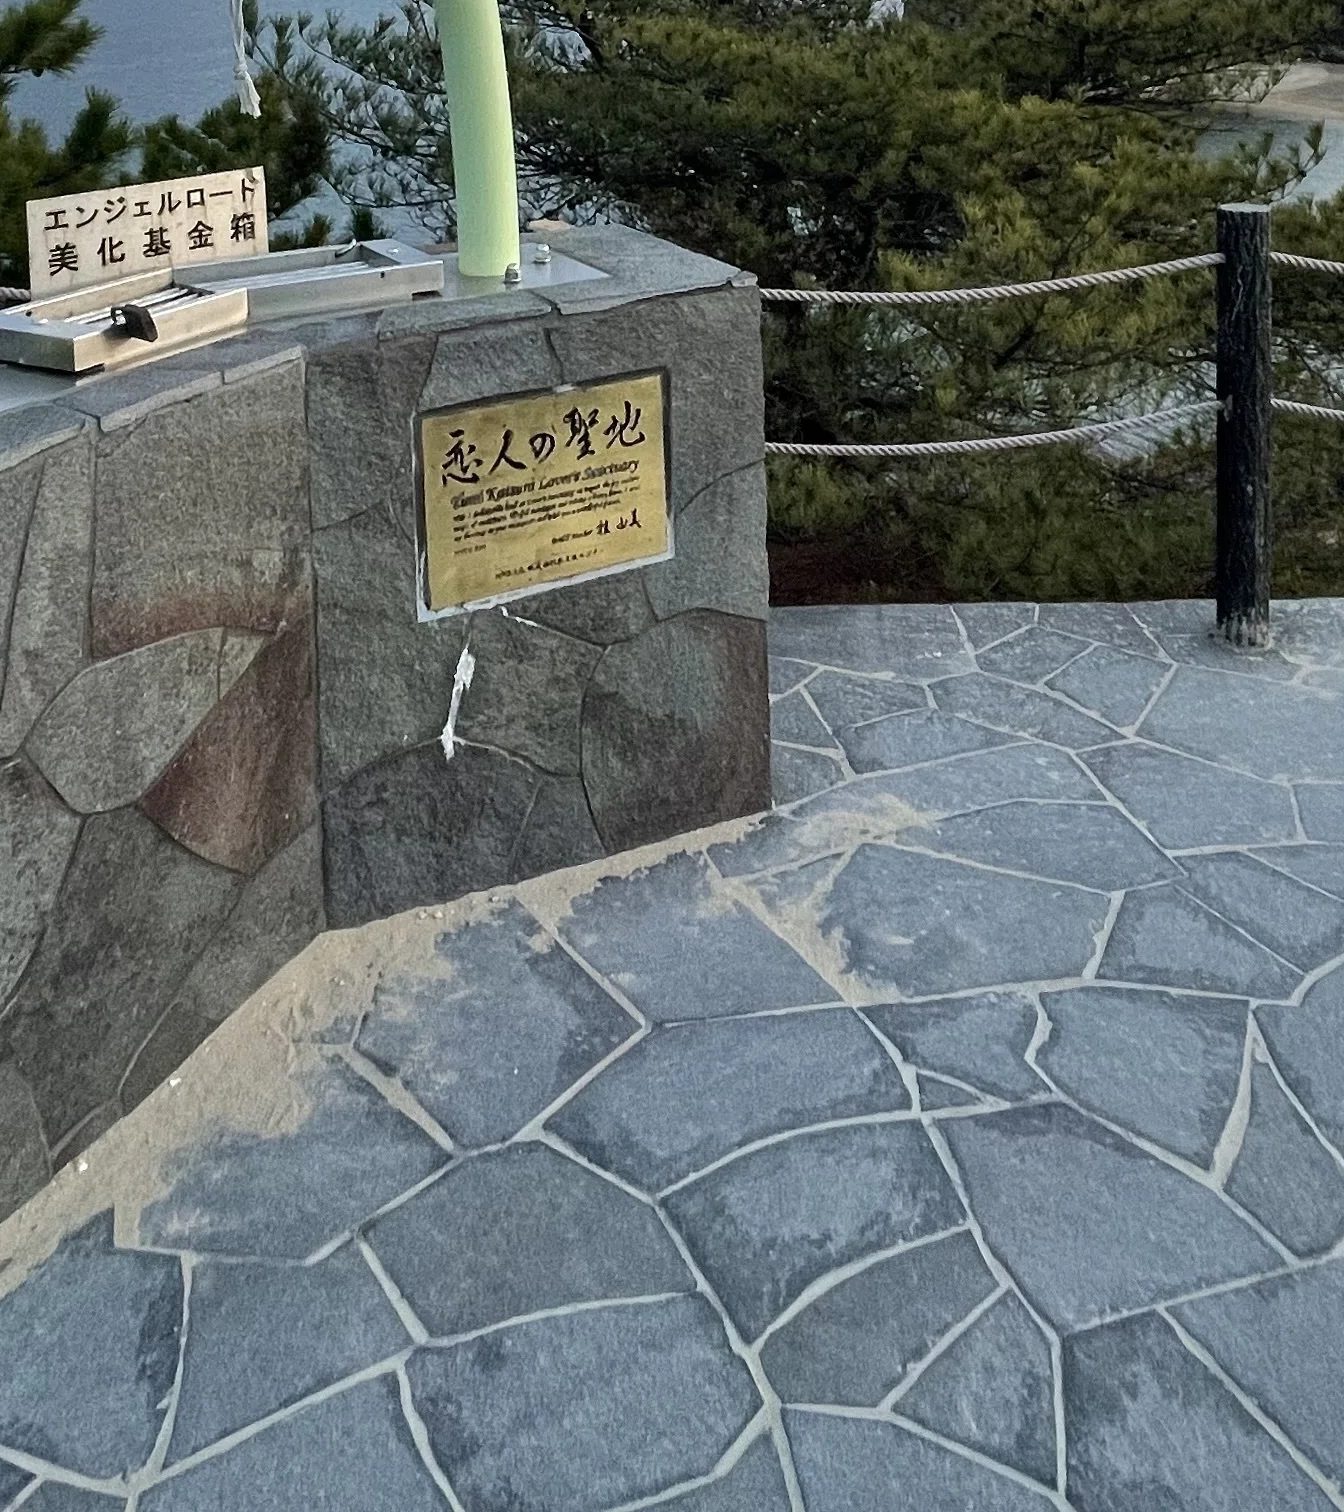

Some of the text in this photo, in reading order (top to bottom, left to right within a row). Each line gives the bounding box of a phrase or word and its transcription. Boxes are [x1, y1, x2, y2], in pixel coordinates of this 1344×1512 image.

[44, 177, 257, 231] エンジェルロード
[48, 212, 255, 276] 美化基金箱
[441, 400, 645, 487] 恋人の聖地
